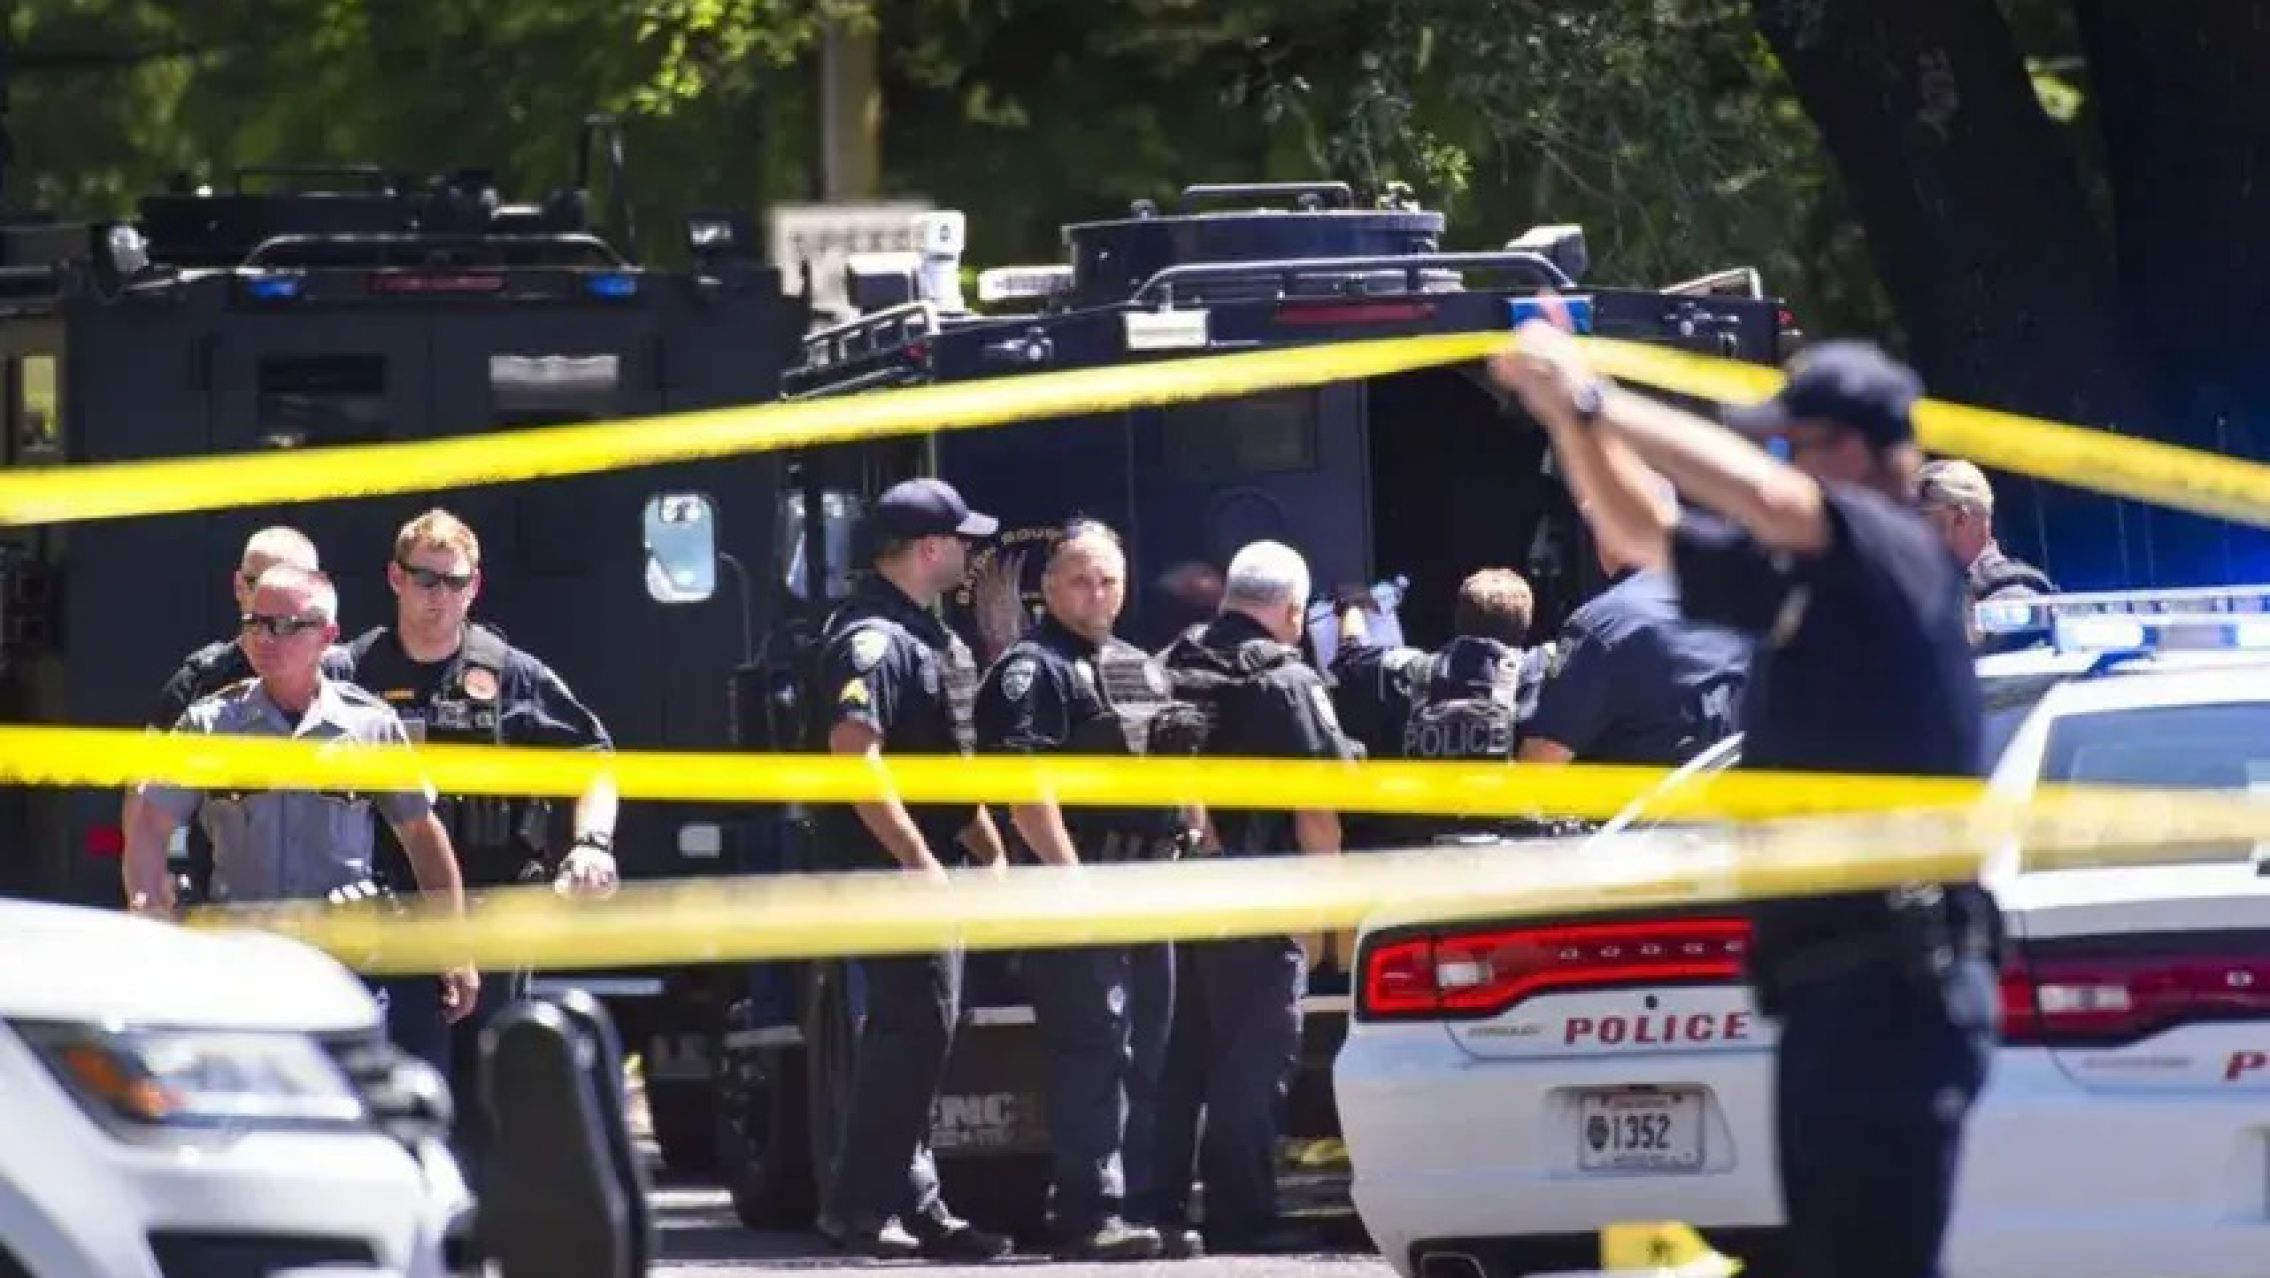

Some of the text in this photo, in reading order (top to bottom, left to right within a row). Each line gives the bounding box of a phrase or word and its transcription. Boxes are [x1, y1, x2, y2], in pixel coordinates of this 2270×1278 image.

[1403, 721, 1509, 757] POLICE
[1564, 1012, 1751, 1045] POLICE
[1613, 1113, 1671, 1149] 1352
